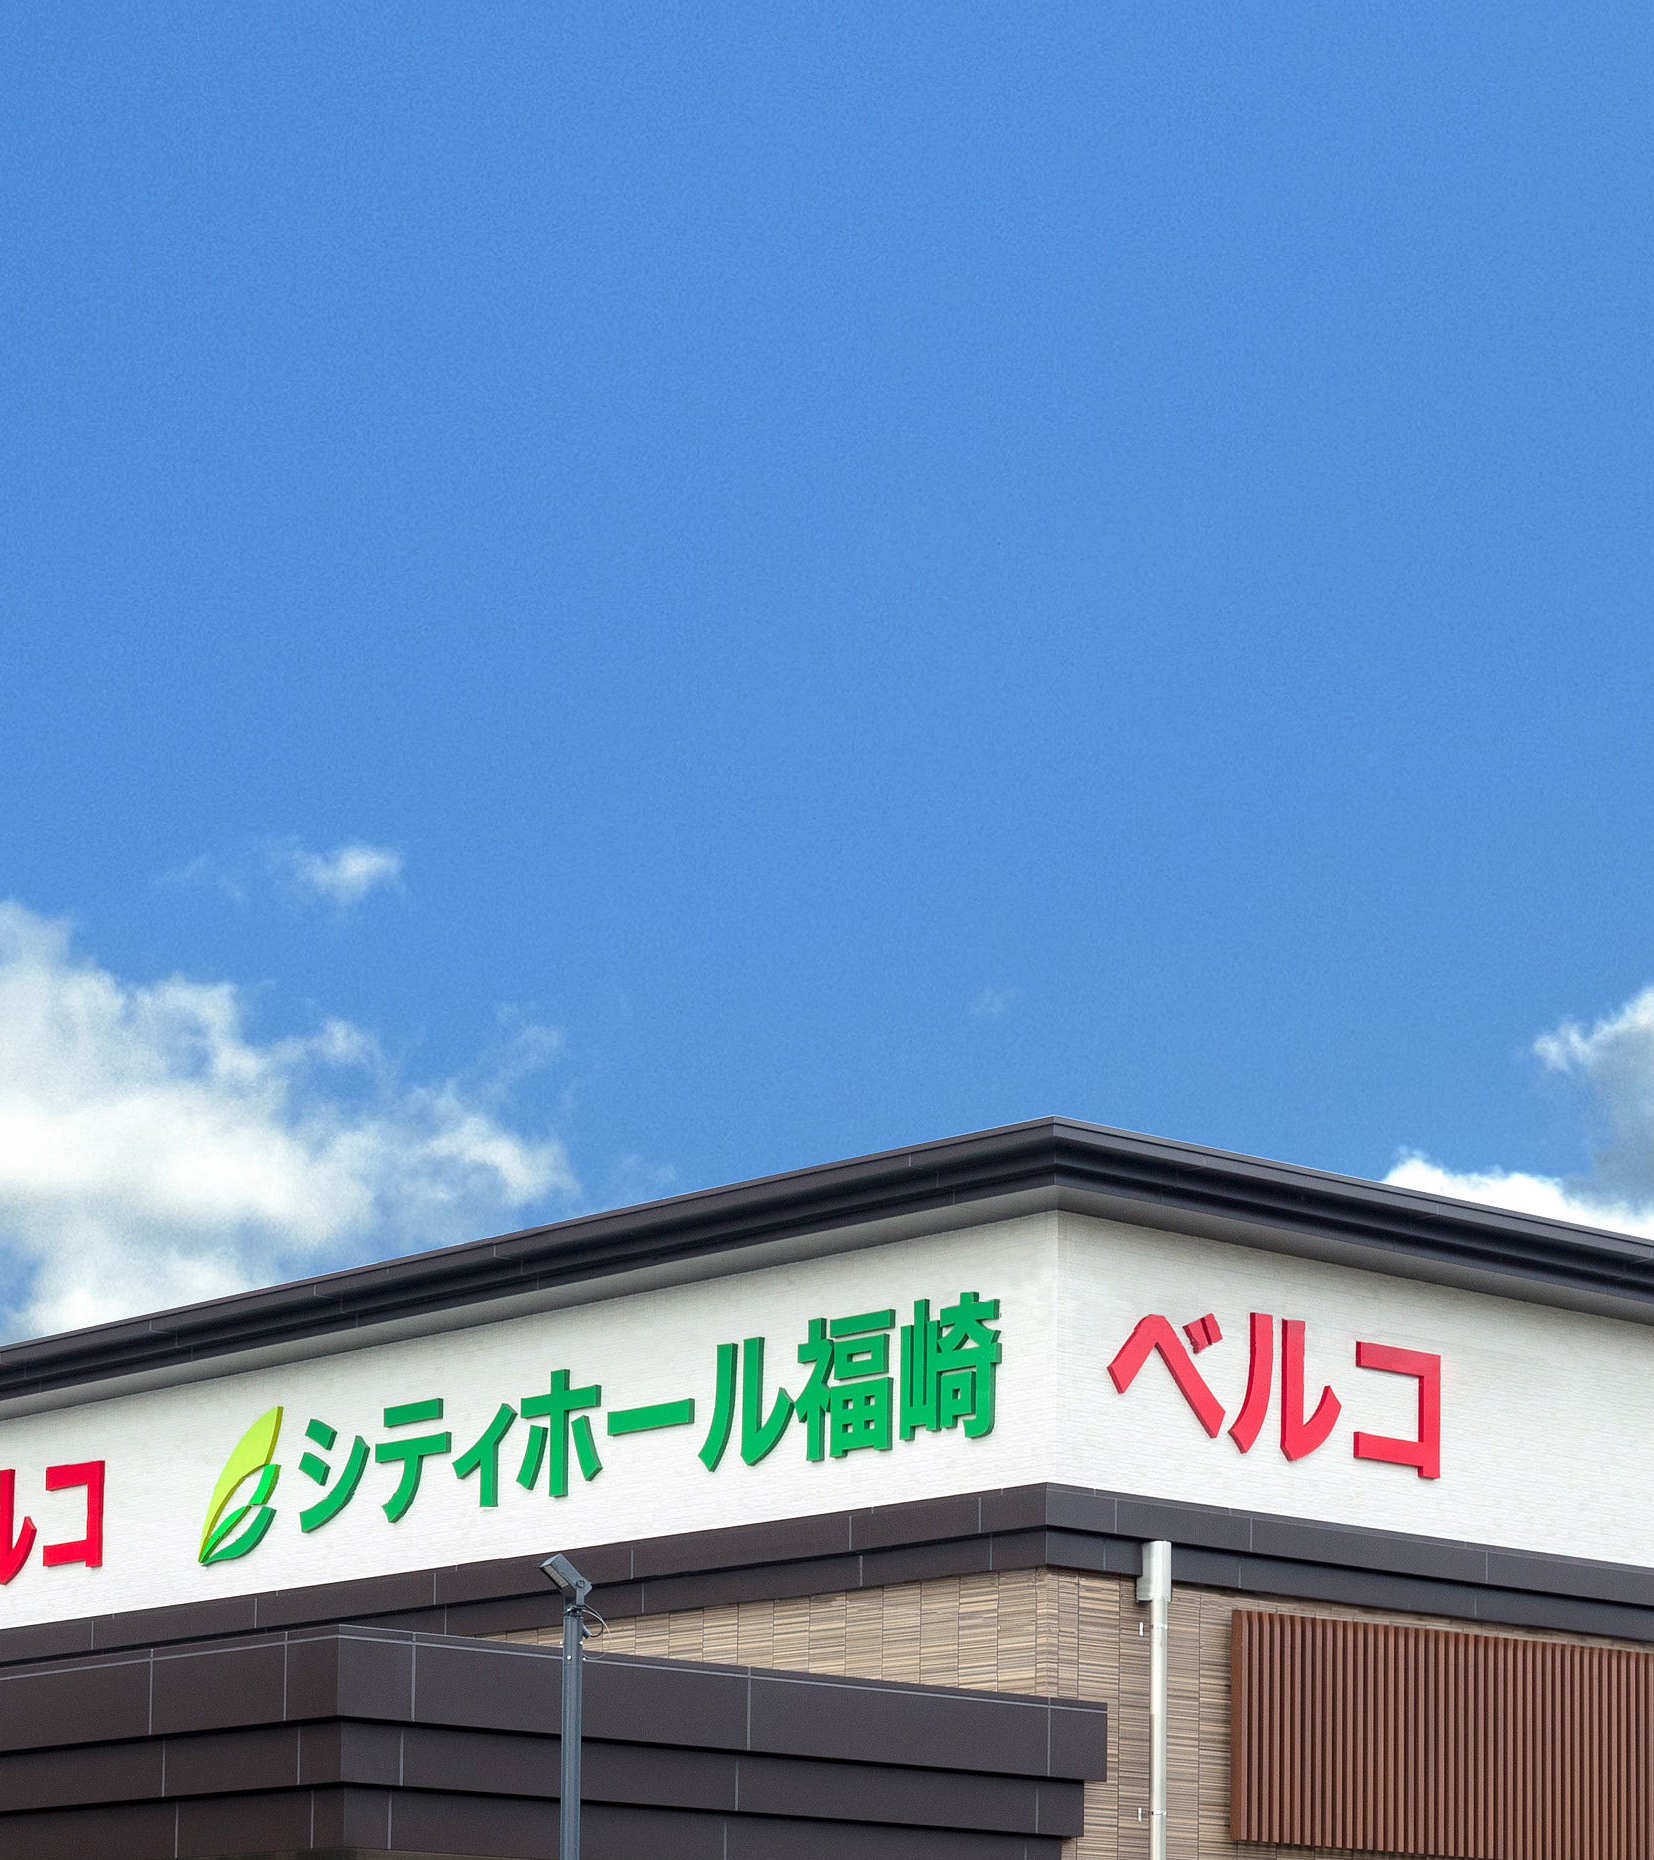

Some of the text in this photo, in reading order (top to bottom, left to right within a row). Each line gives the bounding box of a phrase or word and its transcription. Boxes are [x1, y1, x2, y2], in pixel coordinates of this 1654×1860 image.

[298, 1291, 1002, 1533] シティホール福崎
[1107, 1311, 1442, 1479] ベルコ
